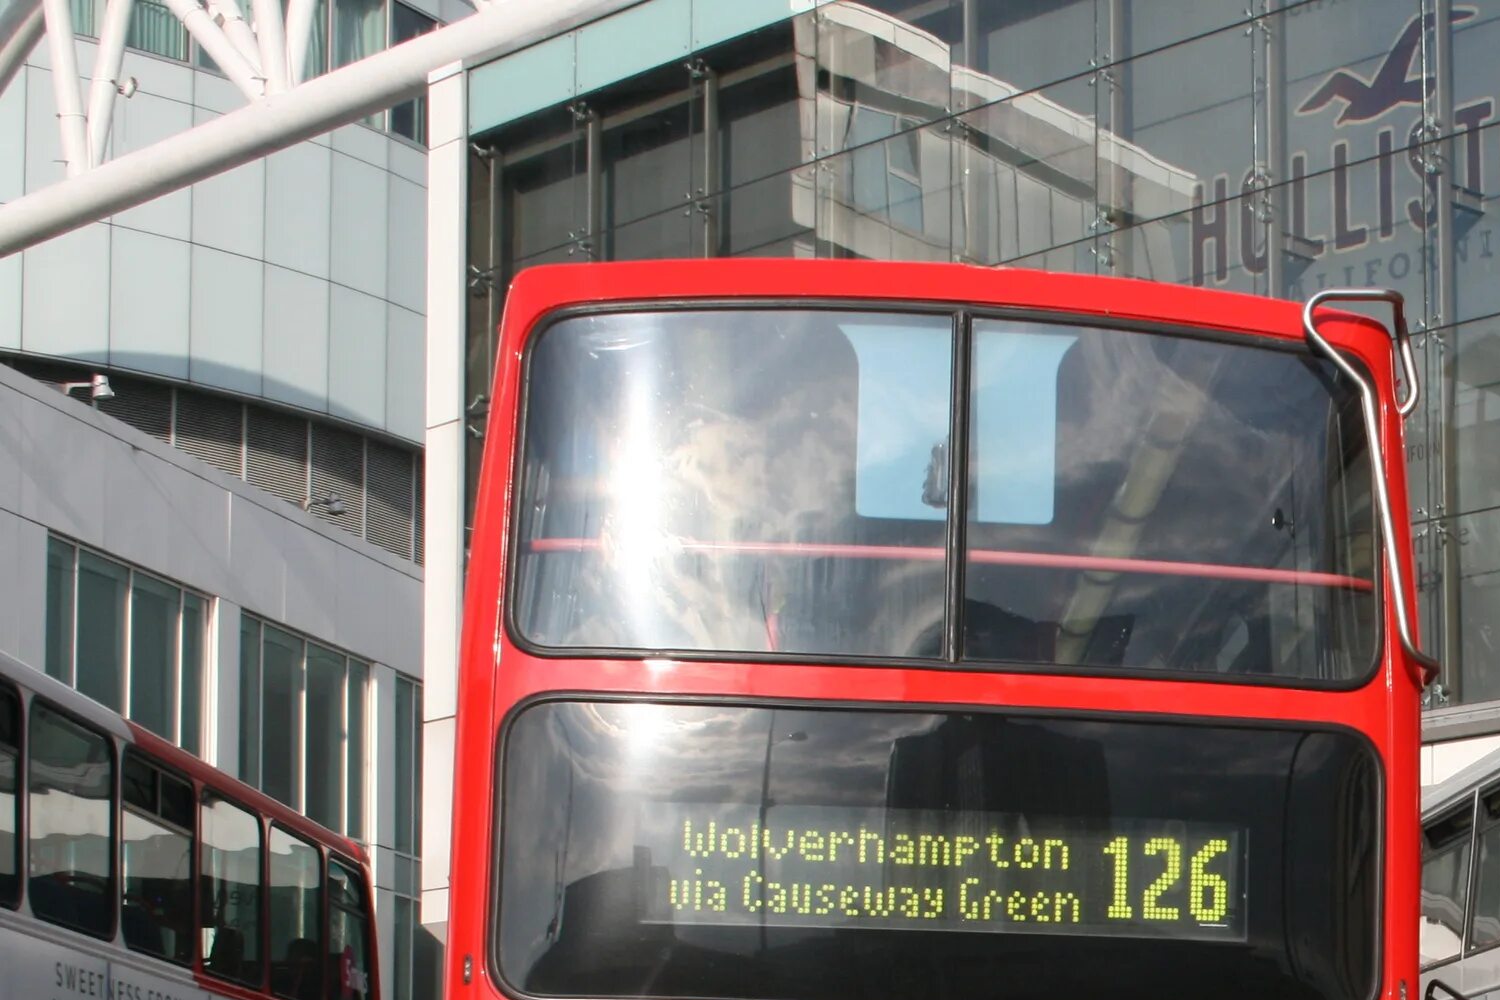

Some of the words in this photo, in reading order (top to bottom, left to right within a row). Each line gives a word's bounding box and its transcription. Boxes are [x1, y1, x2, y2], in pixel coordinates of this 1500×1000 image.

[670, 869, 726, 911] via
[743, 870, 944, 919] Causeway
[960, 877, 1081, 923] Green
[683, 820, 1070, 870] Wolverhampton
[1102, 836, 1230, 921] 126
